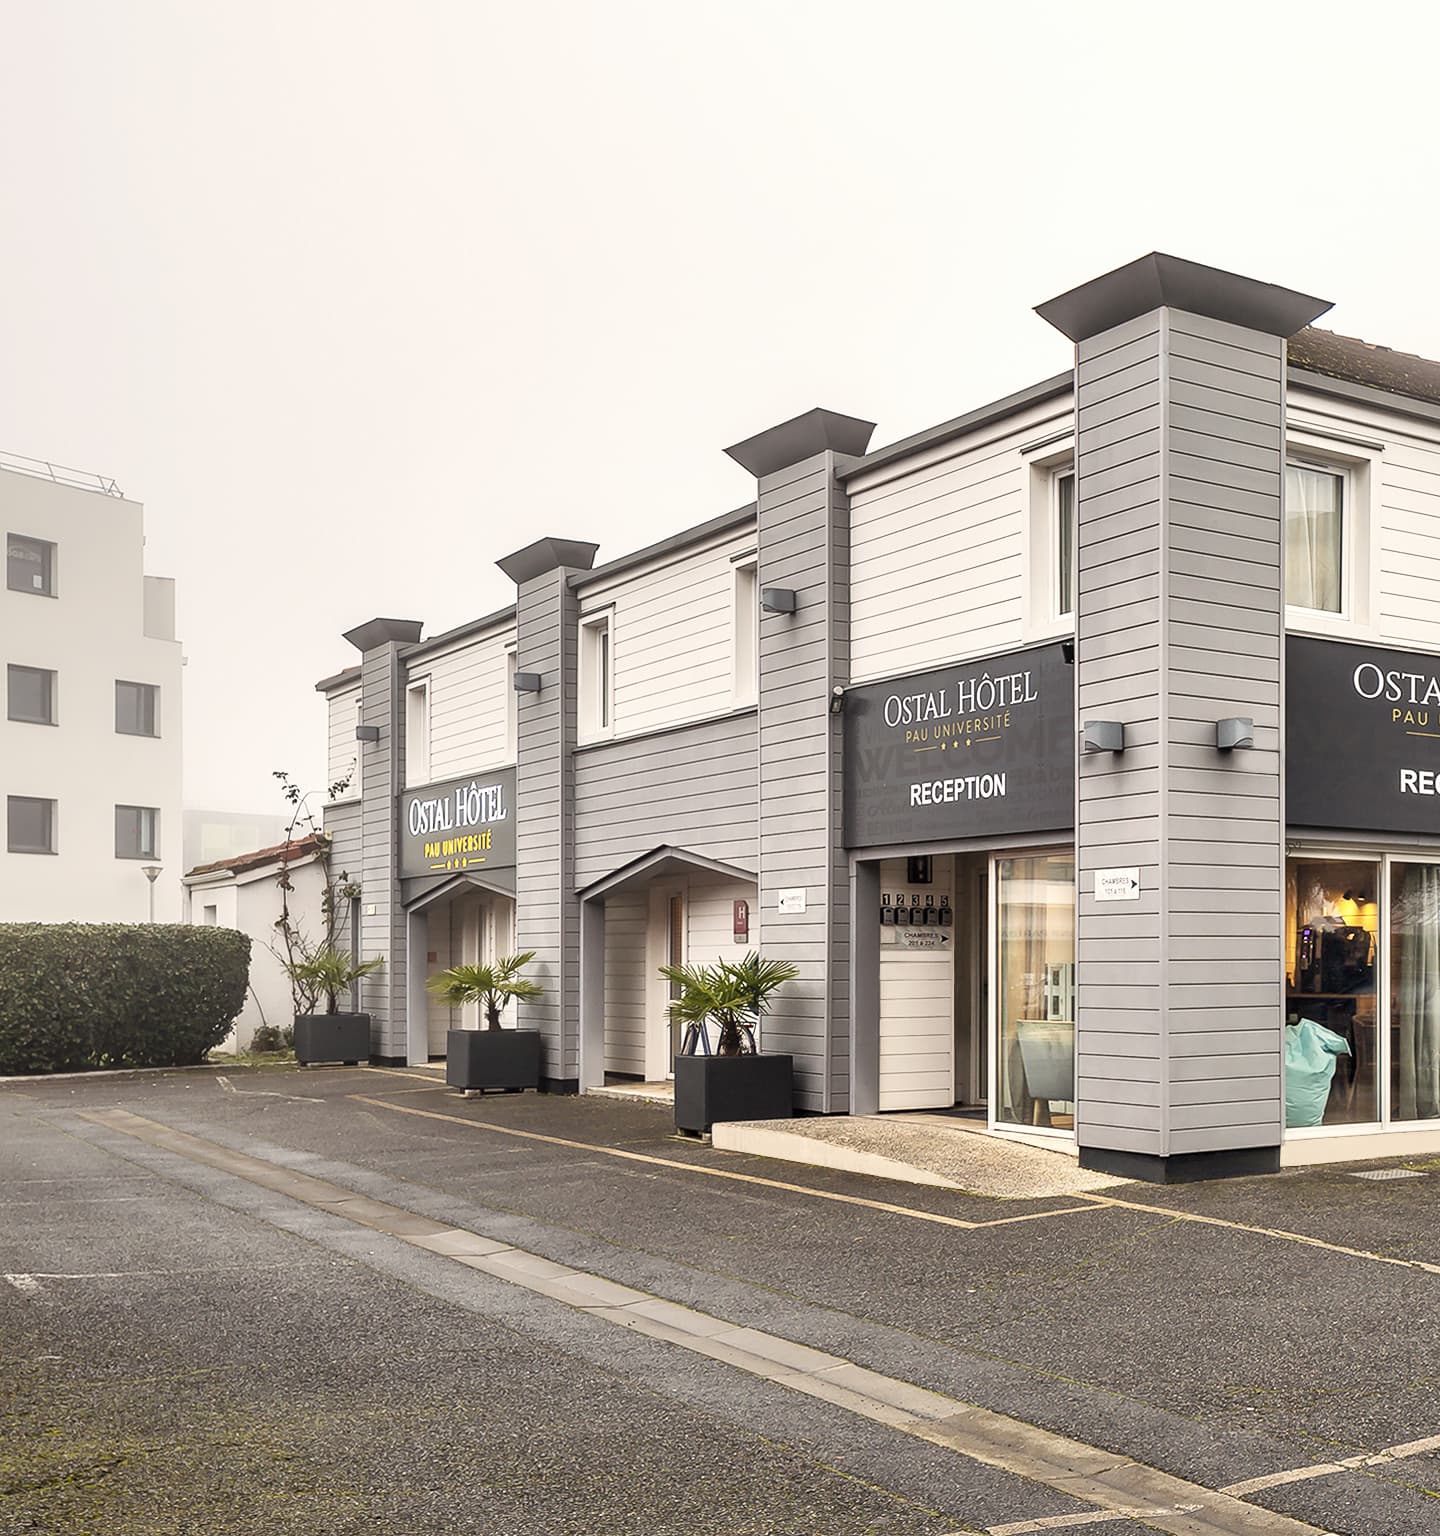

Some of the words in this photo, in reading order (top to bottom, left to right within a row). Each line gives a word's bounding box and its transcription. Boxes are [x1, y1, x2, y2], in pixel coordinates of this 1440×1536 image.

[883, 689, 952, 728] OSTAL
[956, 671, 1039, 716] HÔTEL
[904, 727, 928, 744] PAU
[933, 710, 1012, 740] UNIVERSITÉ
[1392, 708, 1429, 728] PAU
[909, 771, 1007, 808] RECEPTION
[409, 797, 454, 836] OSTAL
[455, 781, 507, 827] HÔTEL
[424, 841, 440, 858] PAU
[442, 829, 492, 856] UNIVERSITÉ
[738, 906, 746, 919] H
